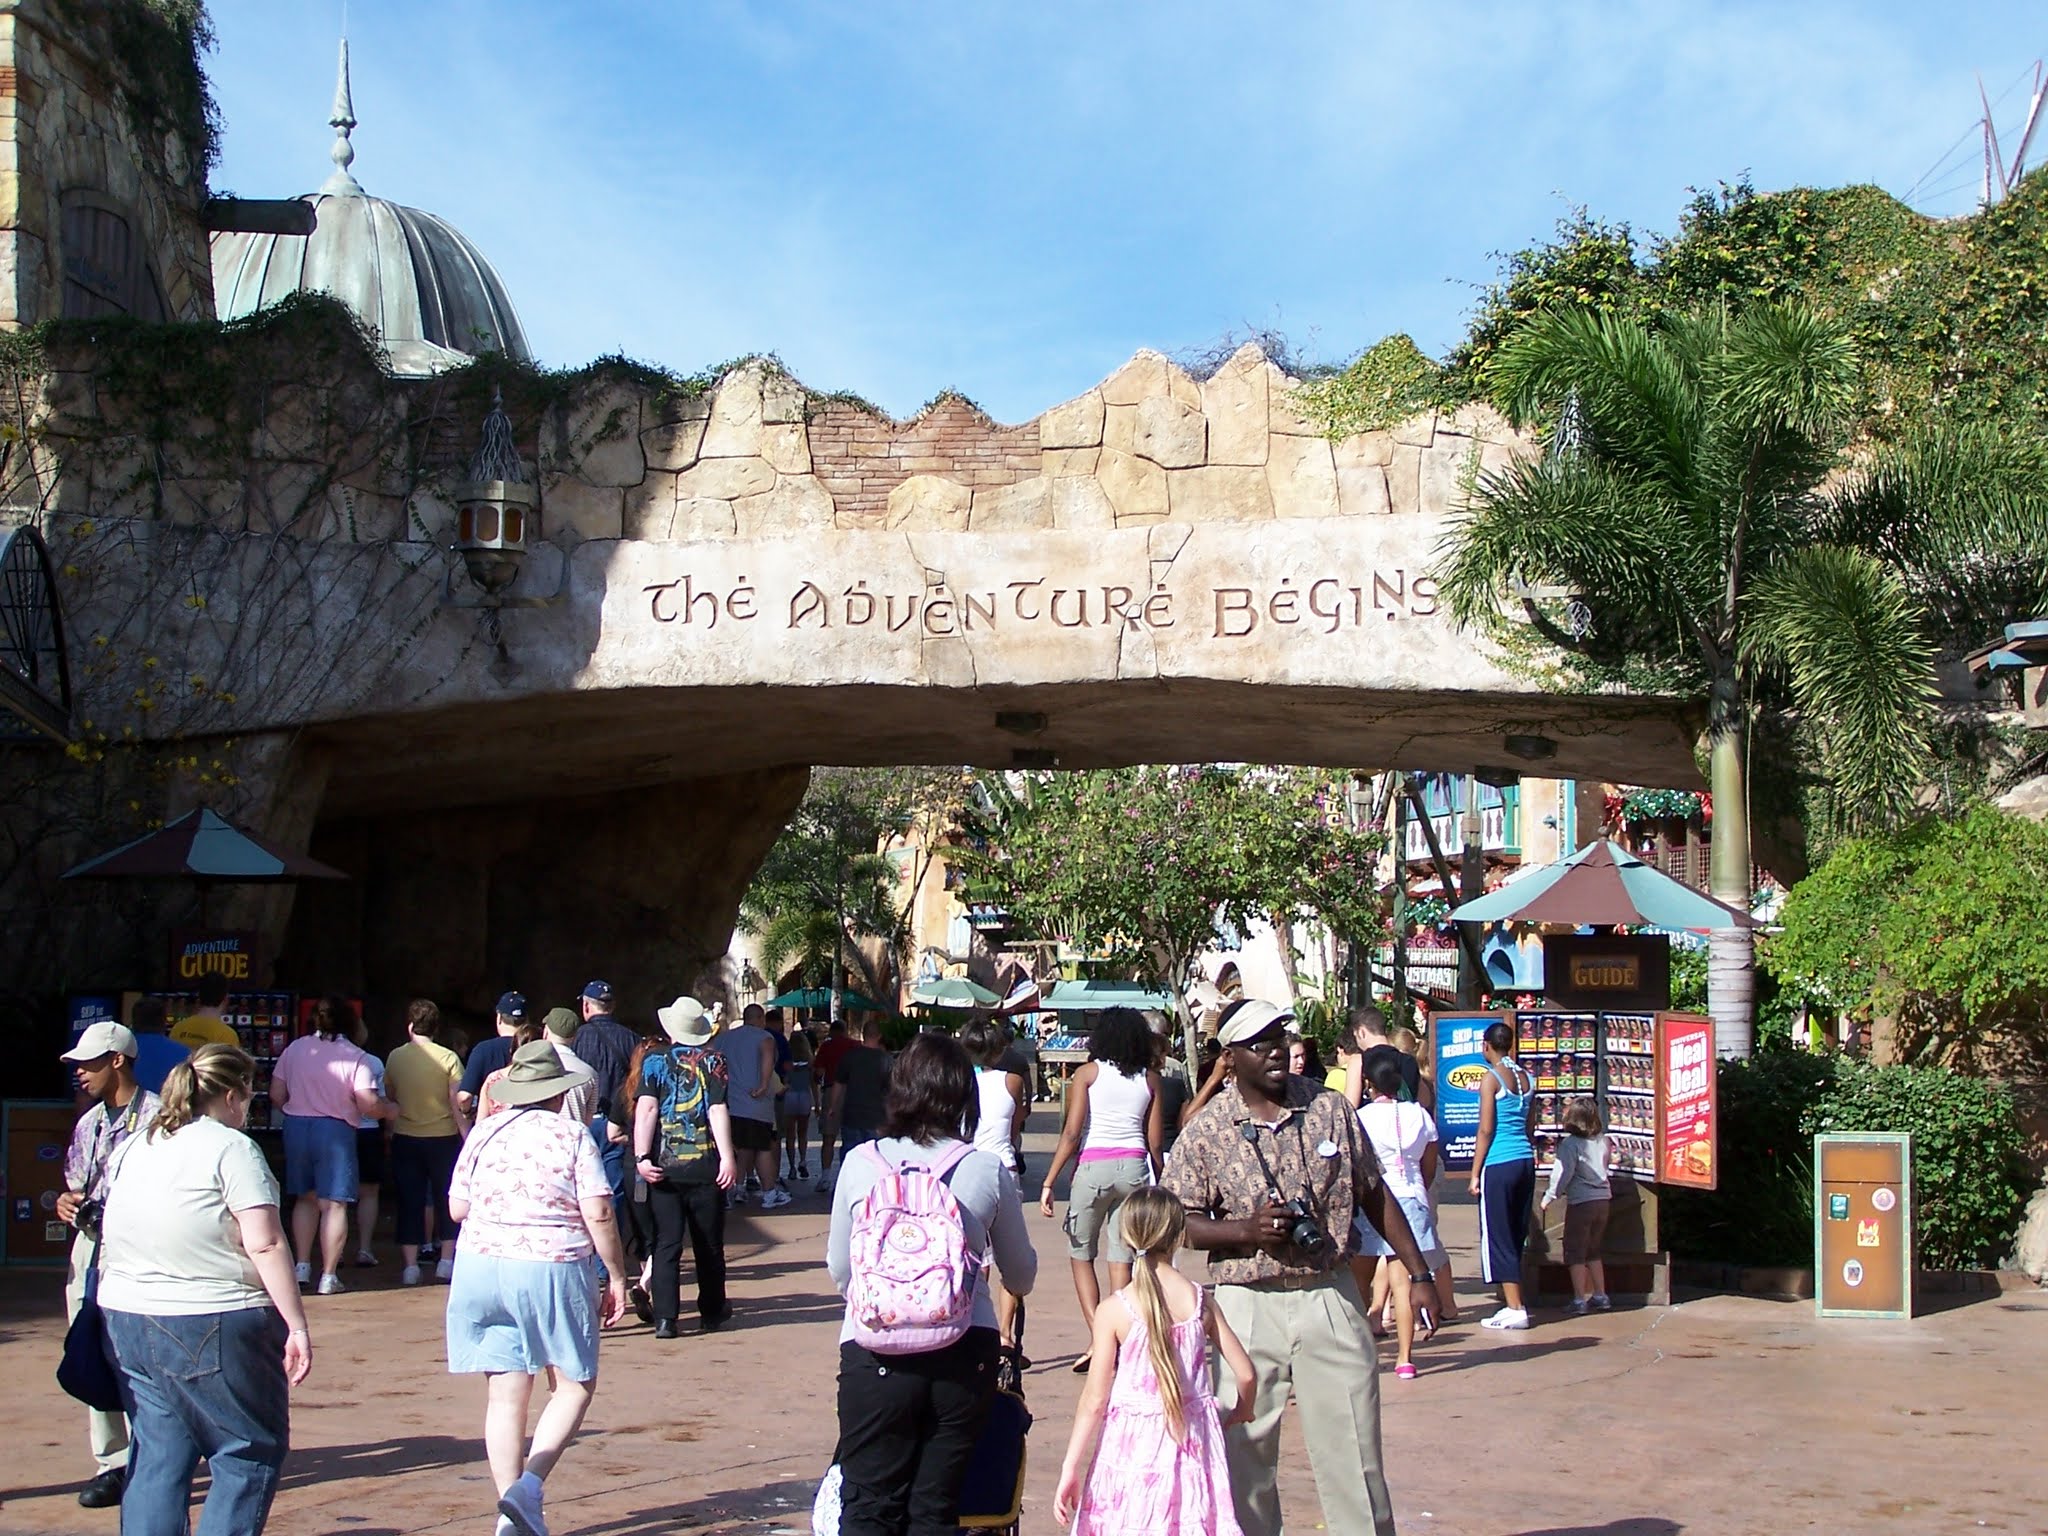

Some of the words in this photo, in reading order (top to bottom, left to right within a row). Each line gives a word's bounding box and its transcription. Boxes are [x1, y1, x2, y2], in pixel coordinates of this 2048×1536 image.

[643, 574, 758, 630] The
[785, 577, 1176, 637] ADVENTURE
[1213, 569, 1439, 638] BEGINS
[184, 938, 240, 956] ADVENTURE
[1423, 951, 1453, 962] ENTRY
[180, 953, 249, 979] GUIDE
[1384, 967, 1452, 987] CISTMAS
[1574, 967, 1634, 986] GUIDE
[1452, 1027, 1473, 1044] SKIP
[1670, 1037, 1707, 1070] Meal
[1452, 1071, 1485, 1086] EXPRES
[1465, 1081, 1481, 1090] PLU
[1670, 1061, 1707, 1097] Deal
